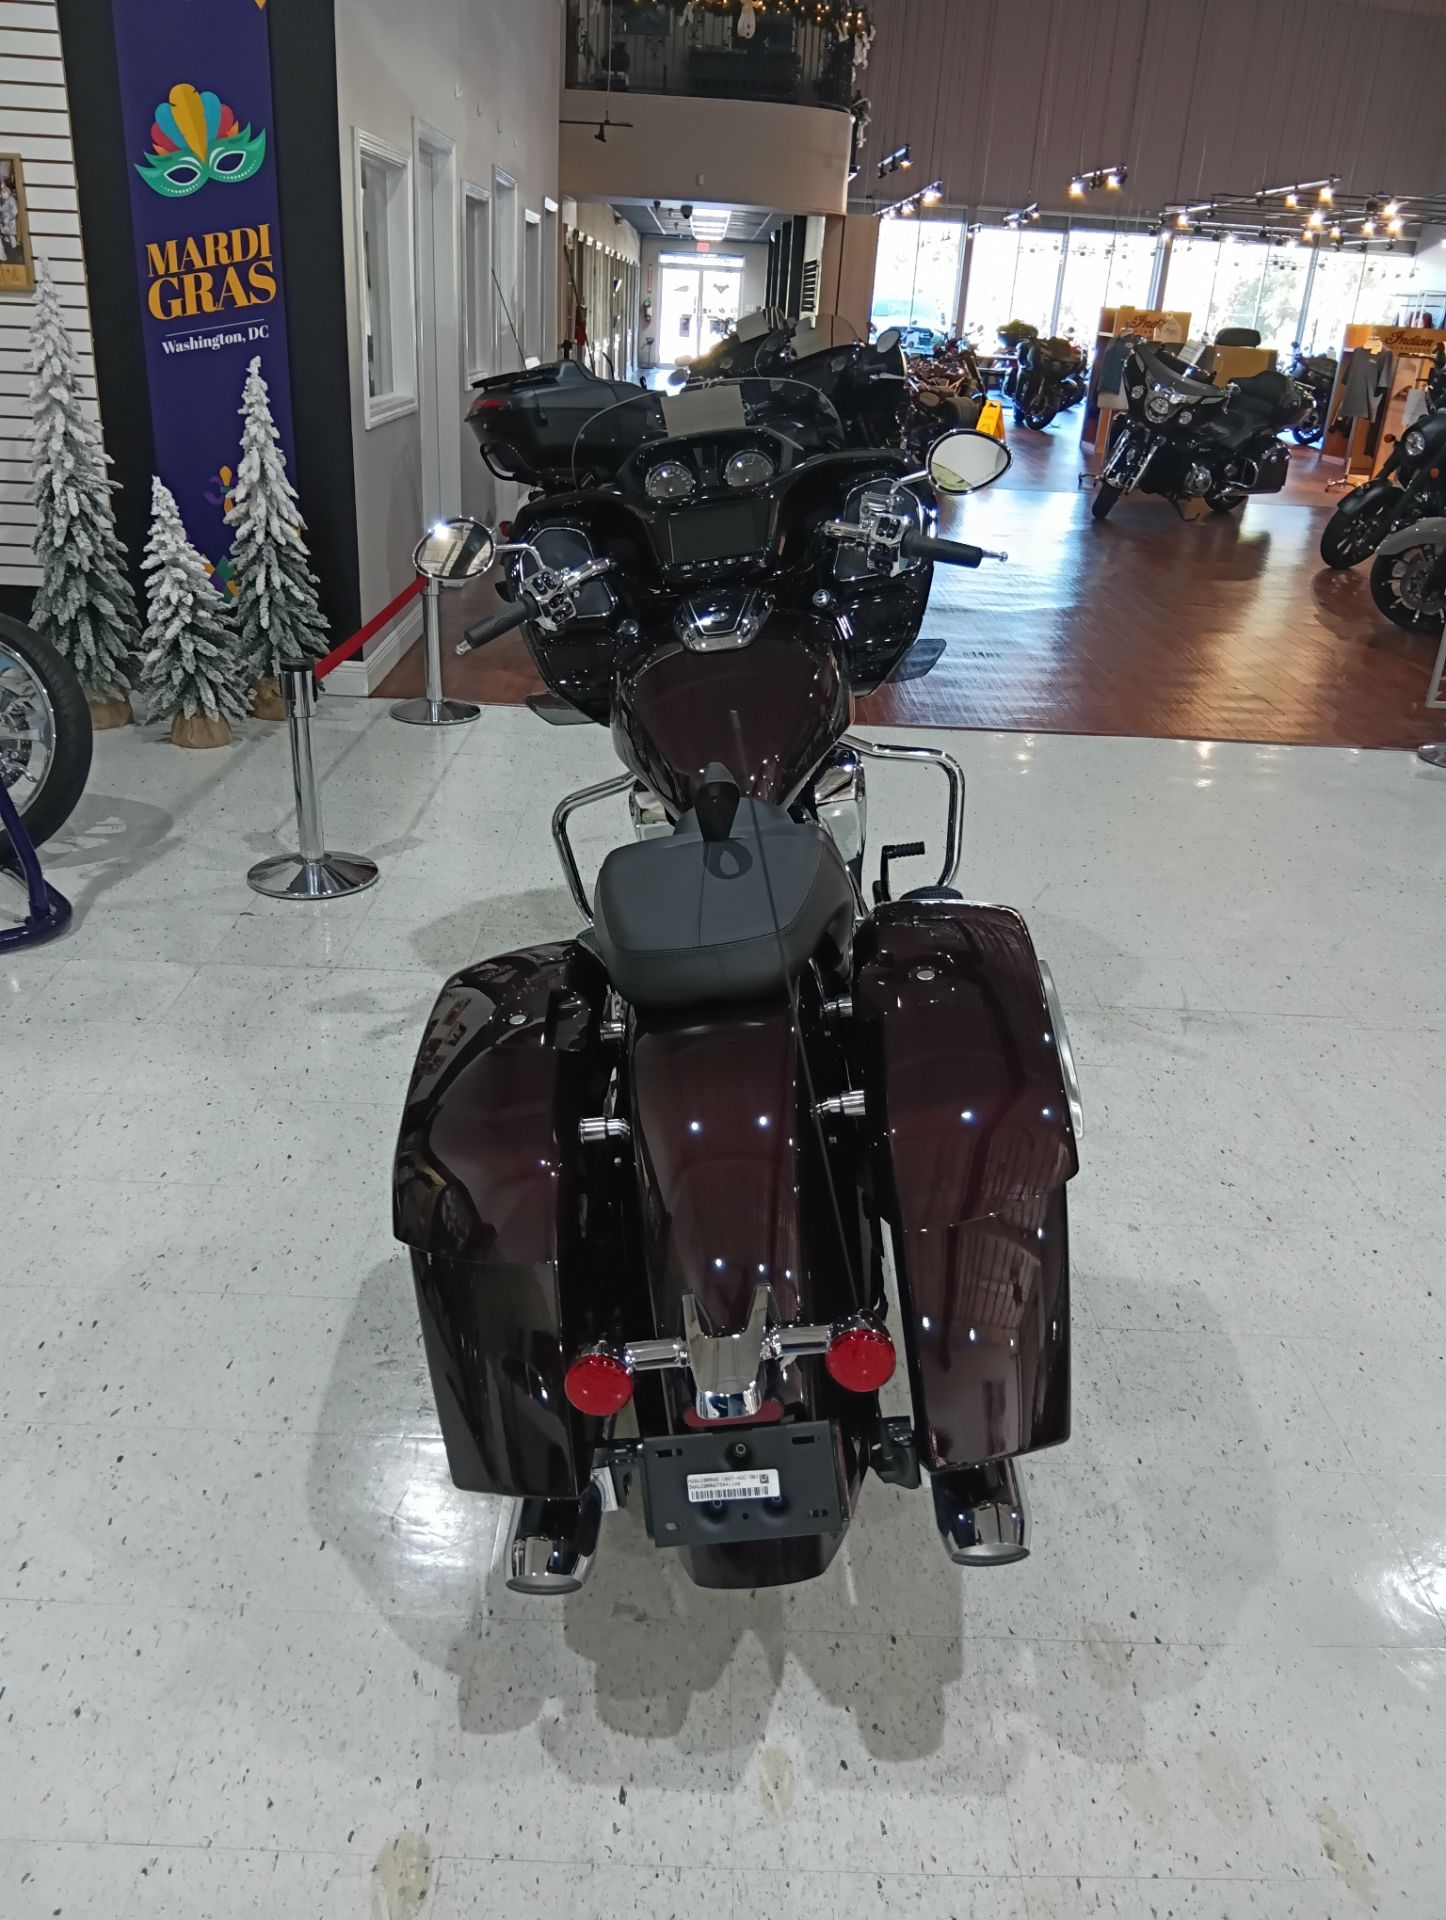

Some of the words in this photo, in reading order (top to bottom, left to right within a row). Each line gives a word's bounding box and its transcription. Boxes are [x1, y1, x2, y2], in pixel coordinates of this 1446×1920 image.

[145, 223, 272, 277] MARDI
[148, 260, 277, 320] GRAS
[162, 331, 246, 355] Washington,
[248, 325, 269, 341] DC
[1384, 330, 1434, 347] Indian
